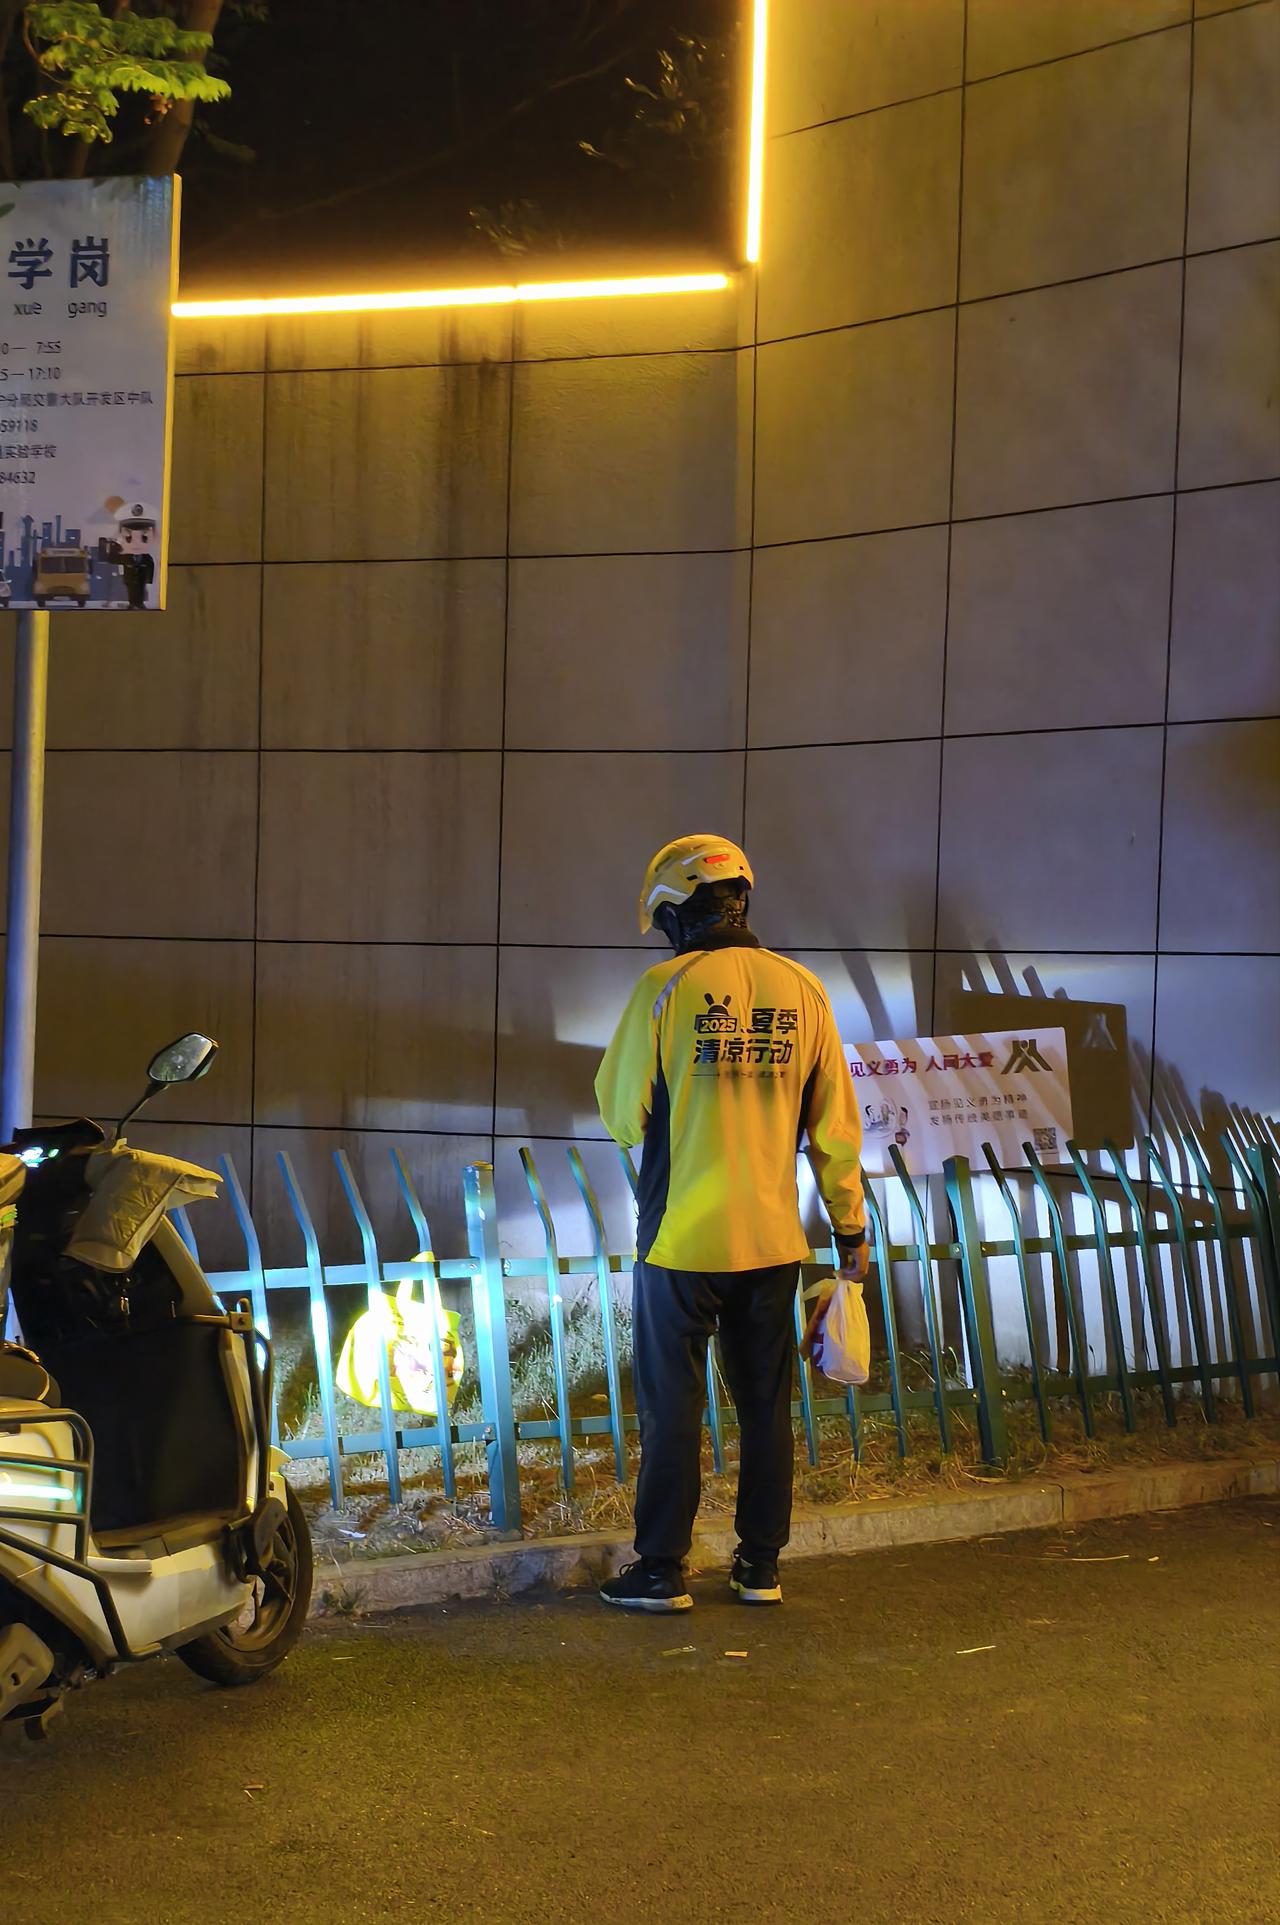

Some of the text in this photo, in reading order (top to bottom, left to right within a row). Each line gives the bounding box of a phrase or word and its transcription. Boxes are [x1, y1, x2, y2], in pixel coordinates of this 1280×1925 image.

[8, 235, 110, 290] 学岗
[13, 301, 108, 318] xue gang
[0, 444, 56, 459] 实验学校
[700, 1008, 798, 1034] 2025 夏季
[694, 1038, 794, 1064] 清凉行动
[850, 1051, 994, 1078] 见义勇为 人间大爱
